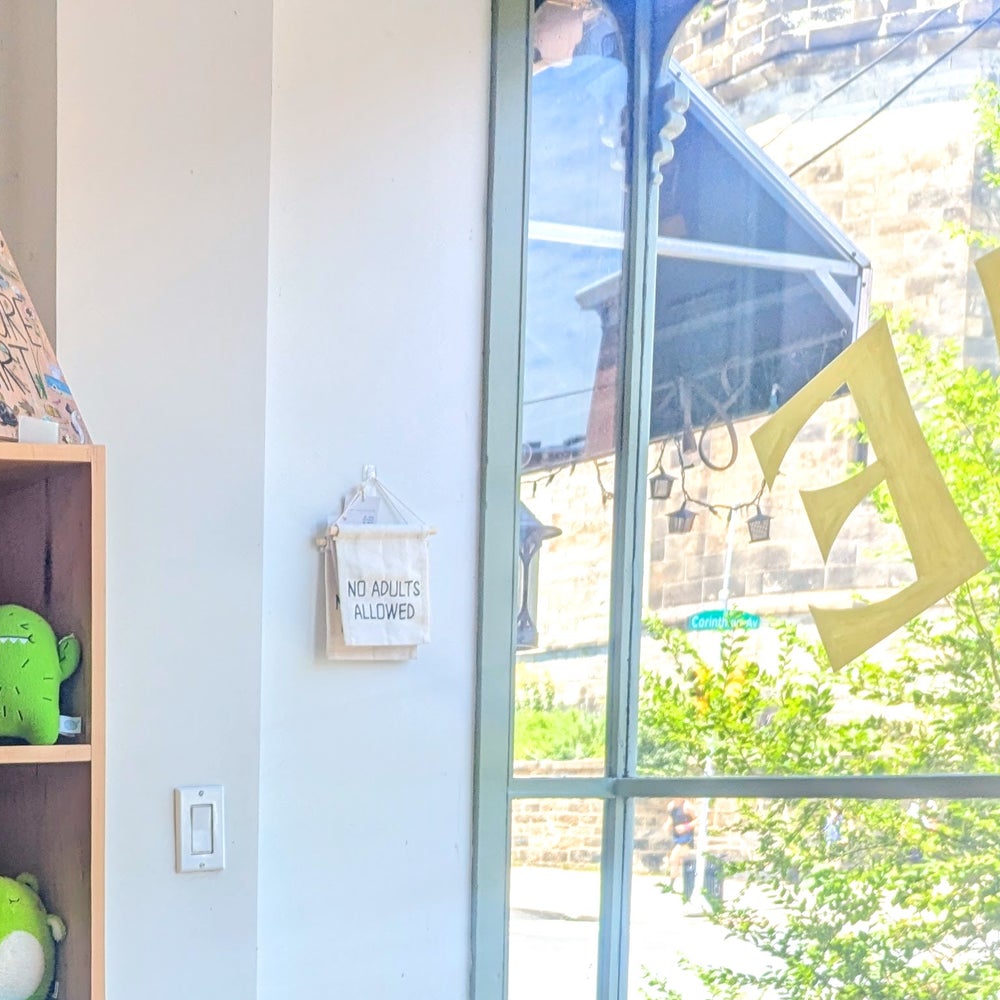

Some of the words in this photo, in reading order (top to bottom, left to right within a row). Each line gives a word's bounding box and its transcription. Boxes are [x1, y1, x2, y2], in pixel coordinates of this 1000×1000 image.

[348, 581, 366, 597] NO
[372, 580, 420, 597] ADULTS
[355, 603, 415, 620] ALLOWED
